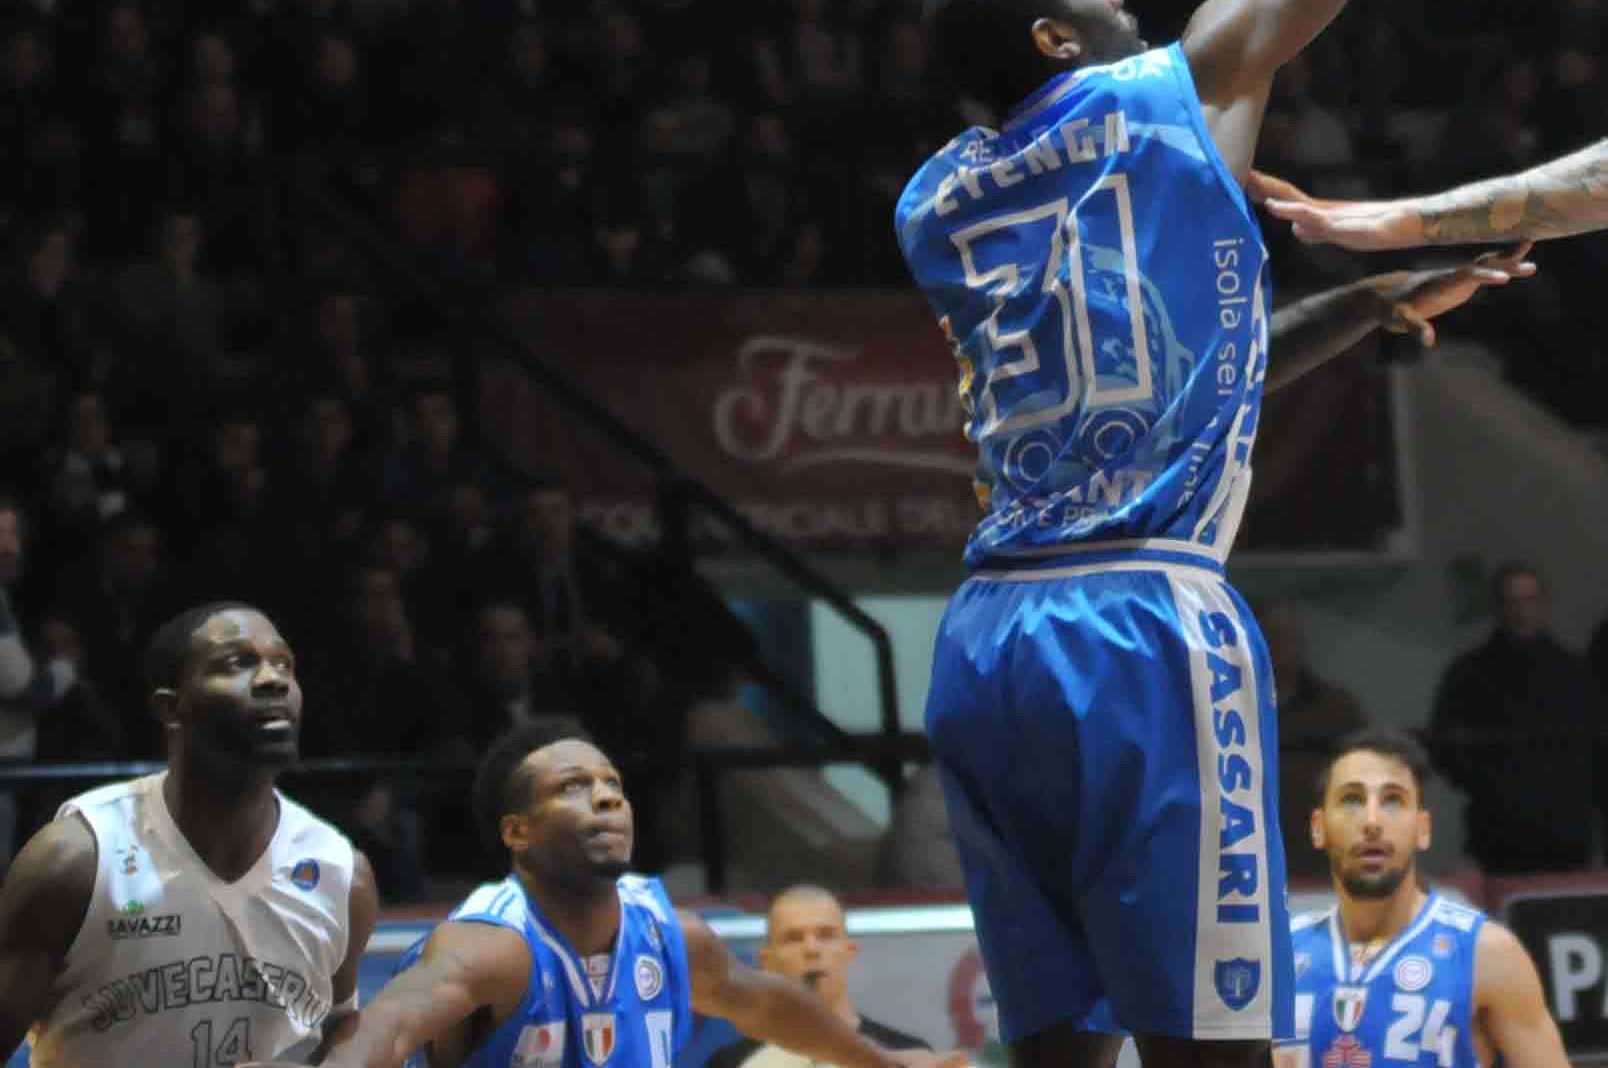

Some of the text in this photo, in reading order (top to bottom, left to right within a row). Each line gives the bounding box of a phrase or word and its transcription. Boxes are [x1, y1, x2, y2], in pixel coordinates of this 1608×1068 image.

[1213, 237, 1248, 330] isola
[1199, 610, 1260, 924] SASSARI
[191, 1017, 251, 1068] 14
[1384, 992, 1458, 1068] 24
